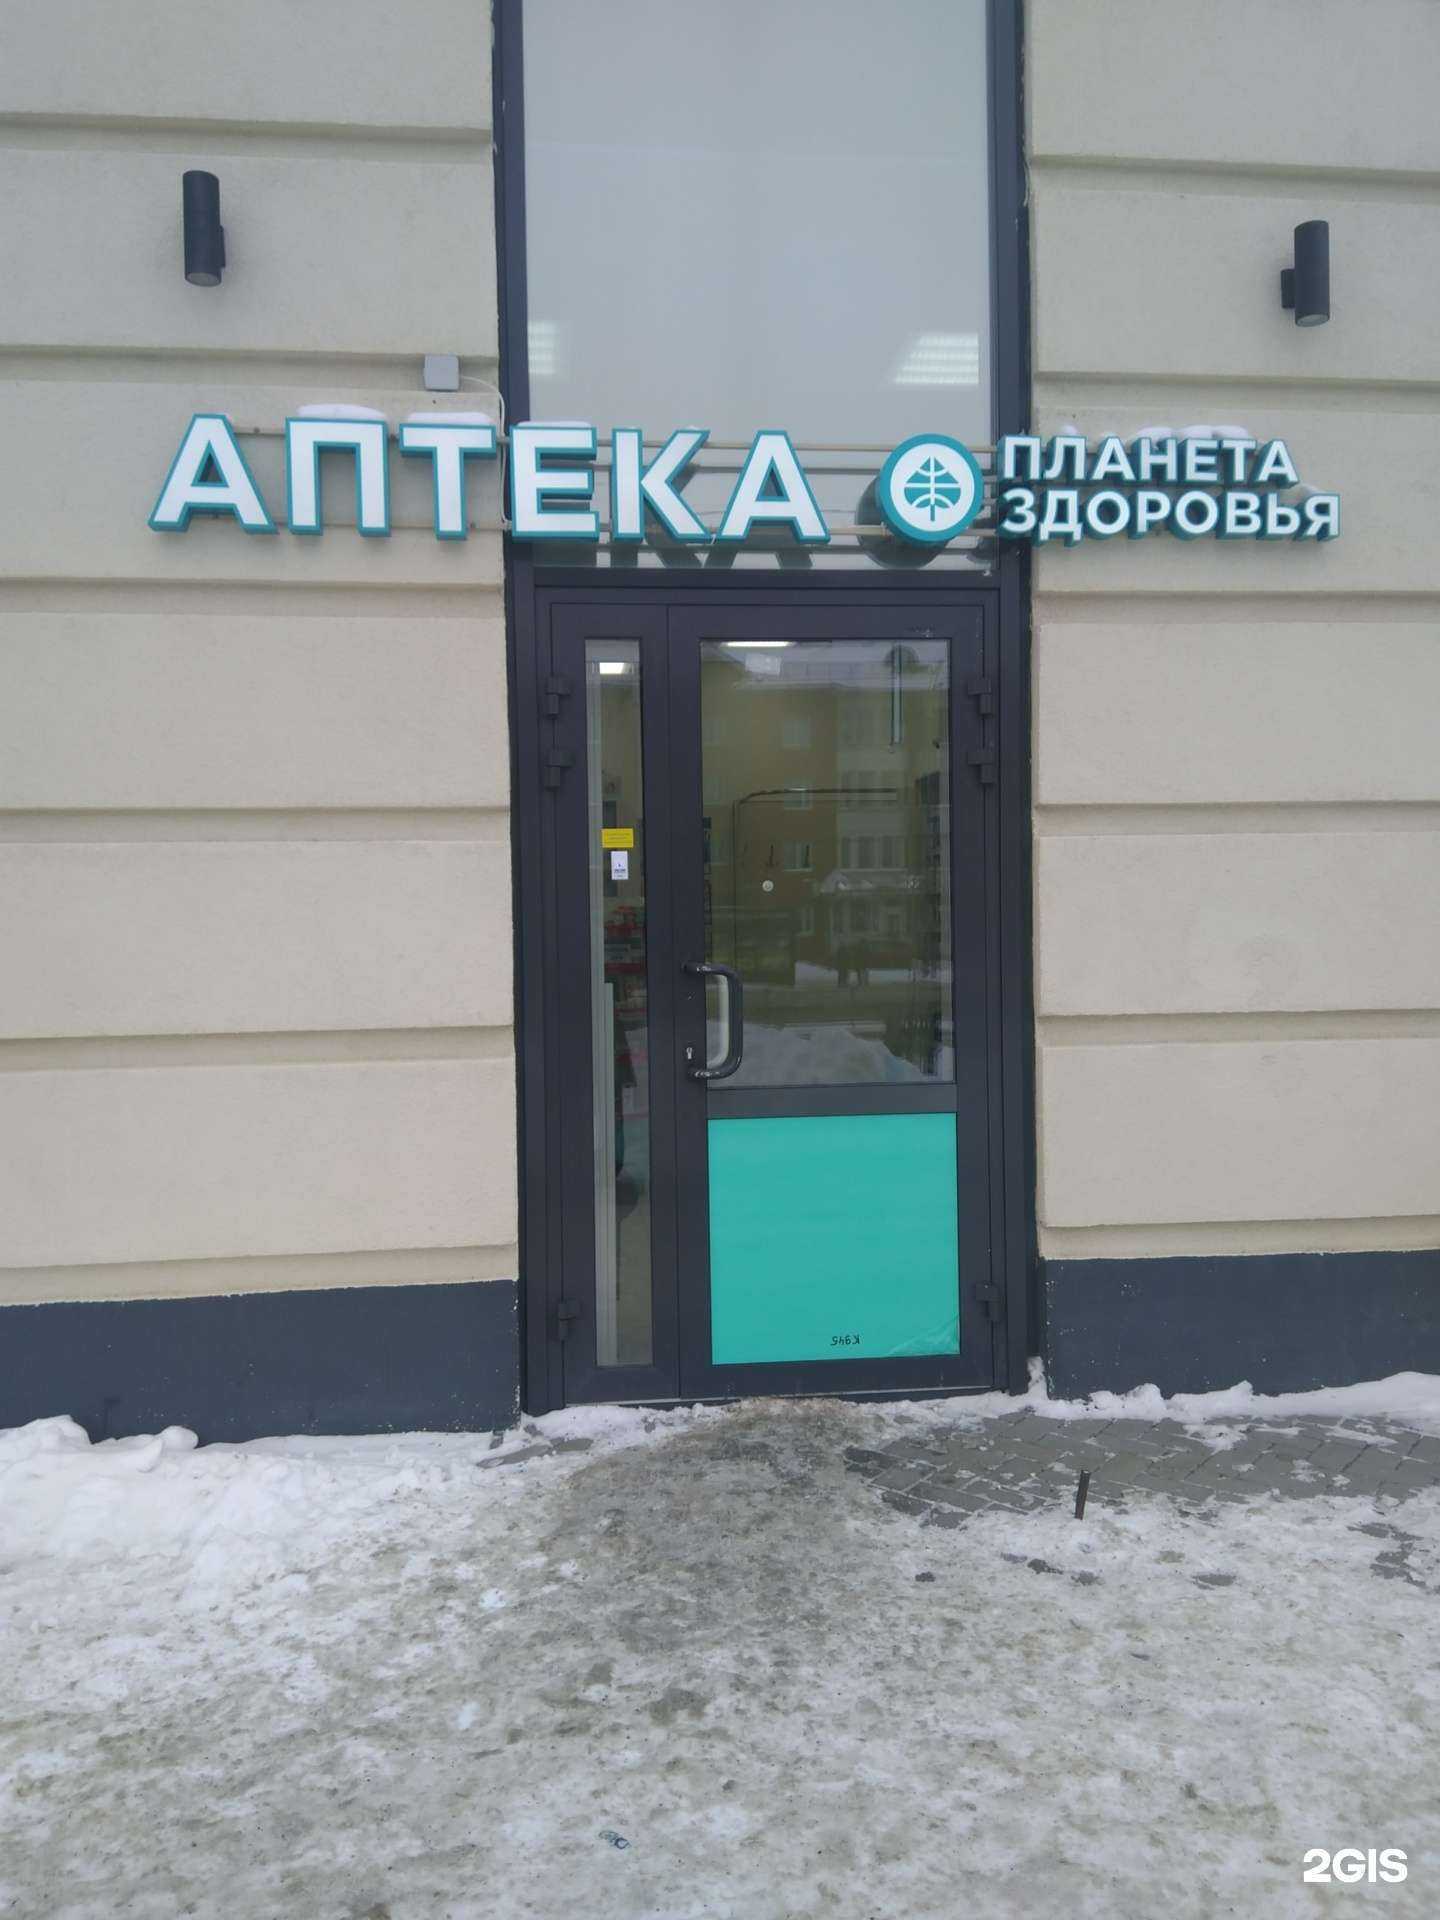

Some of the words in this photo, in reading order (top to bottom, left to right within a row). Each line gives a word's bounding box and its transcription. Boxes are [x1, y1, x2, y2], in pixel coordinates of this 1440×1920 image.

[148, 413, 830, 542] АПТЕКА
[1002, 435, 1299, 484] ПЛАНЕТА
[1001, 487, 1341, 541] ЗДОРОВЬЯ
